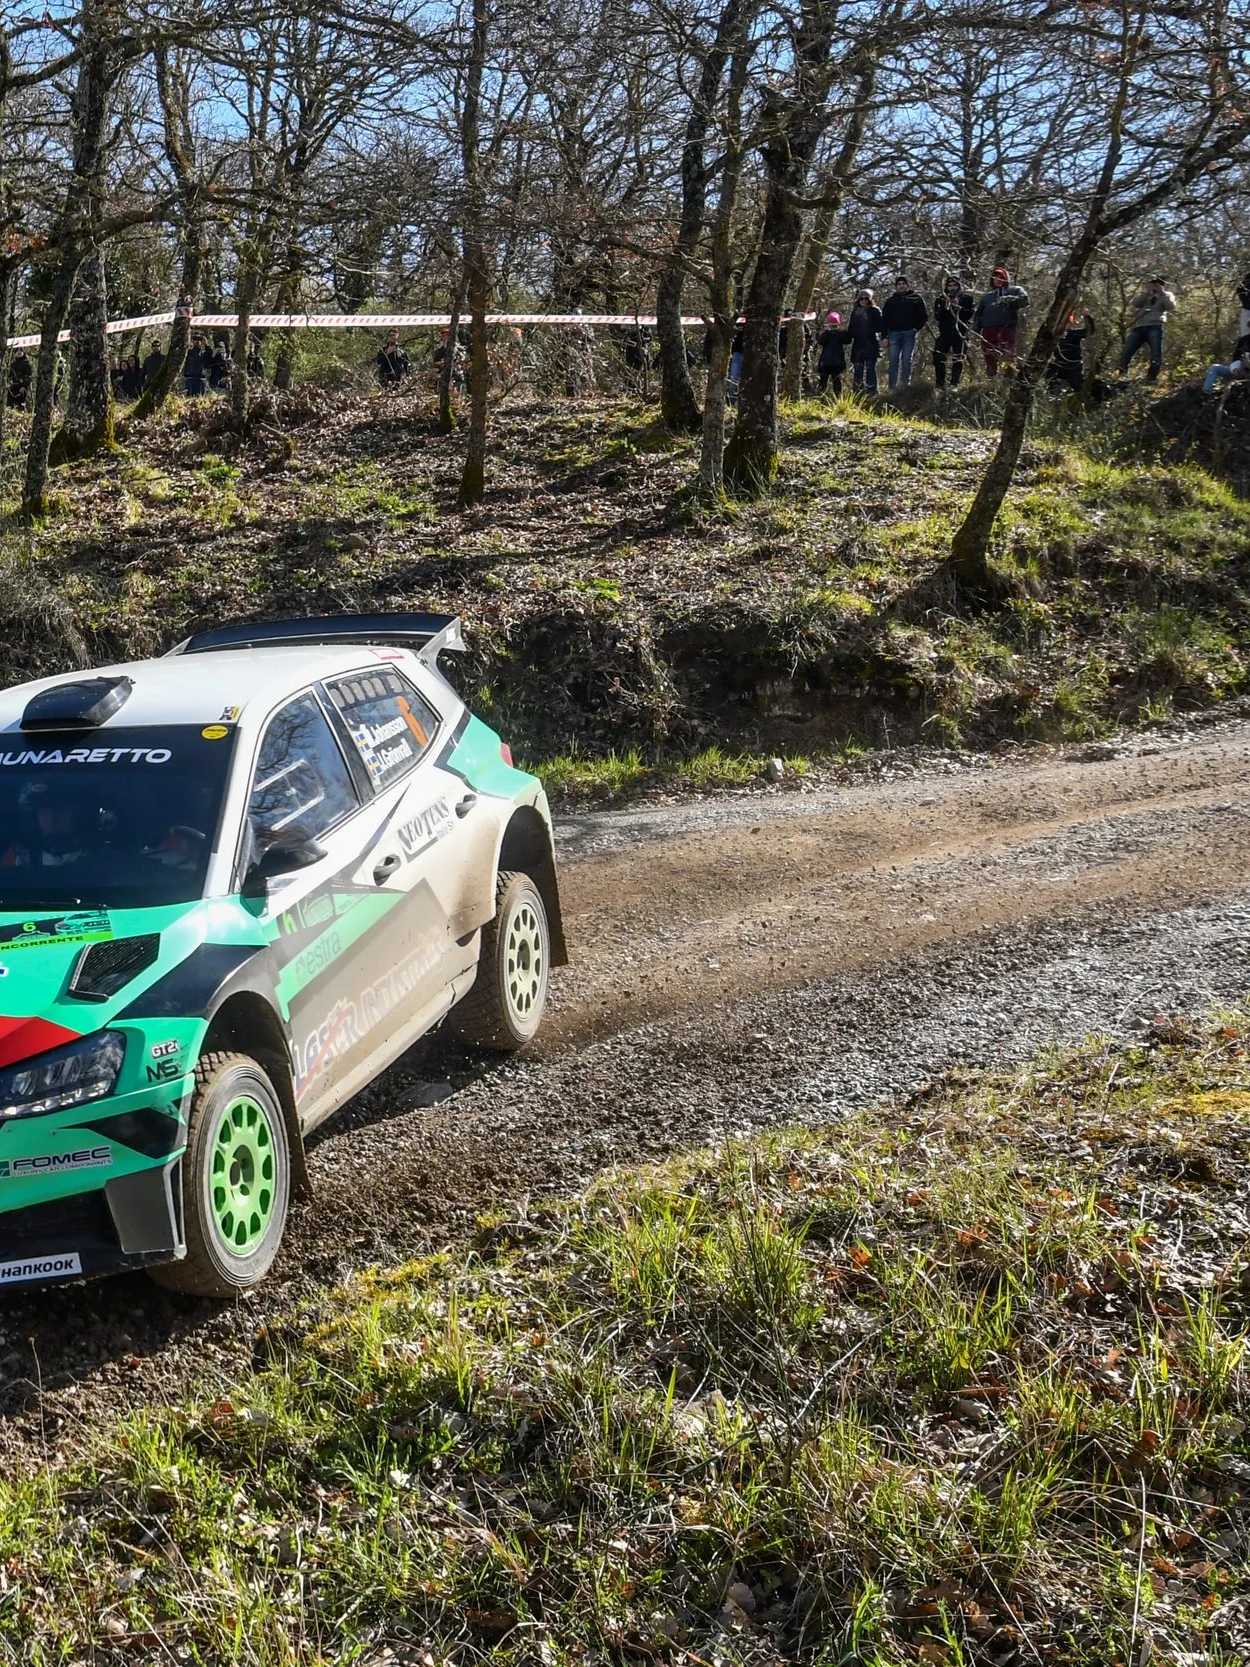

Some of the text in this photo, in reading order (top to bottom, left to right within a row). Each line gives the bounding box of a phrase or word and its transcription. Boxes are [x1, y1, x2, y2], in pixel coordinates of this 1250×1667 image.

[22, 921, 37, 932] 6
[145, 1058, 179, 1083] MS
[12, 1146, 111, 1171] FOMEC
